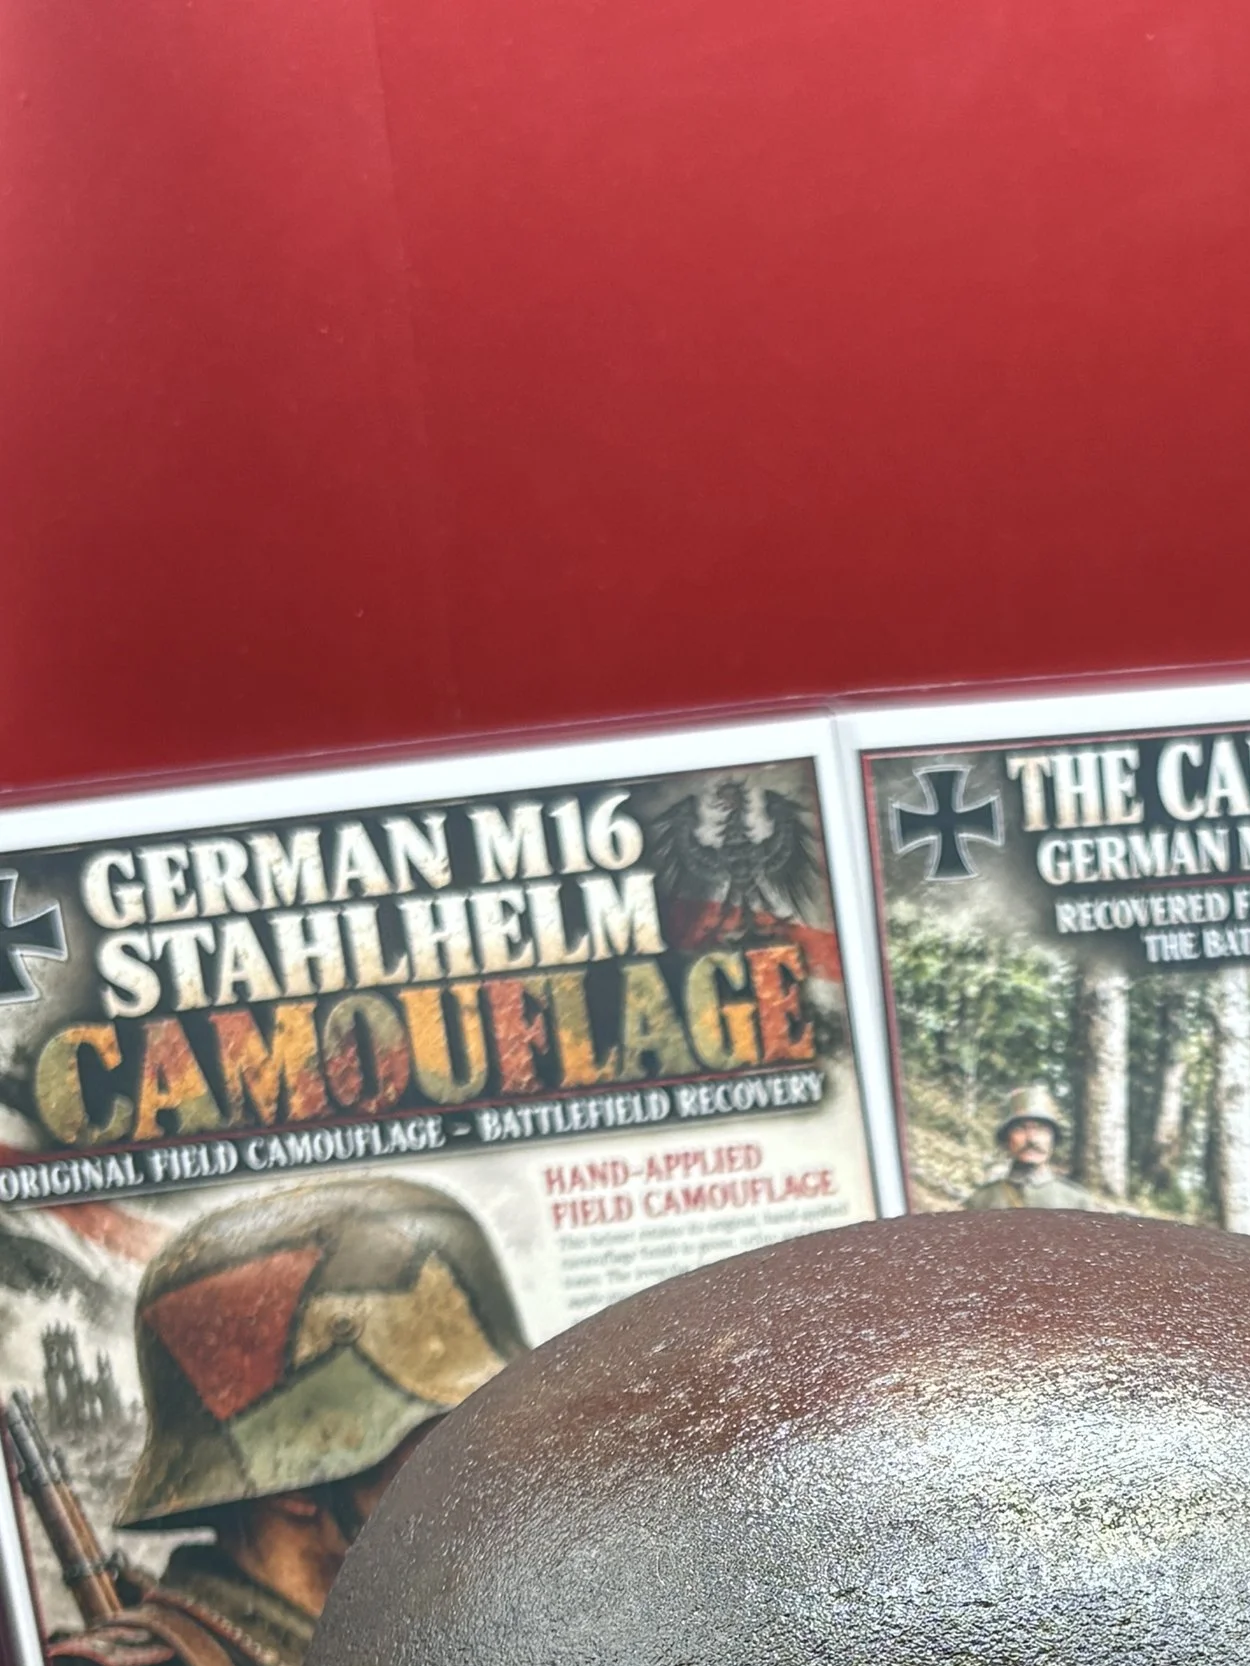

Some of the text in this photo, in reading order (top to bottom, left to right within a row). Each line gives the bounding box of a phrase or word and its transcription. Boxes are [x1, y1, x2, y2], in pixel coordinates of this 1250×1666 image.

[1006, 747, 1144, 835] THE
[83, 790, 647, 931] GERMAN M16
[1035, 825, 1231, 888] GERMAN
[93, 868, 666, 1019] STAHLHELM
[1055, 887, 1227, 935] RECOVERED
[1143, 930, 1200, 963] THE
[28, 942, 819, 1152] CAMOUFLAGE
[0, 1151, 144, 1200] ORIGINAL
[150, 1138, 239, 1184] FIELD
[243, 1114, 447, 1172] CAMOUFLAGE
[476, 1087, 674, 1143] BATTLEFIELD
[675, 1068, 828, 1118] RECOVERY
[542, 1145, 764, 1195] HAND-APPLIED
[551, 1193, 634, 1230] FIELD
[641, 1167, 838, 1218] CAMOUFLAGE
